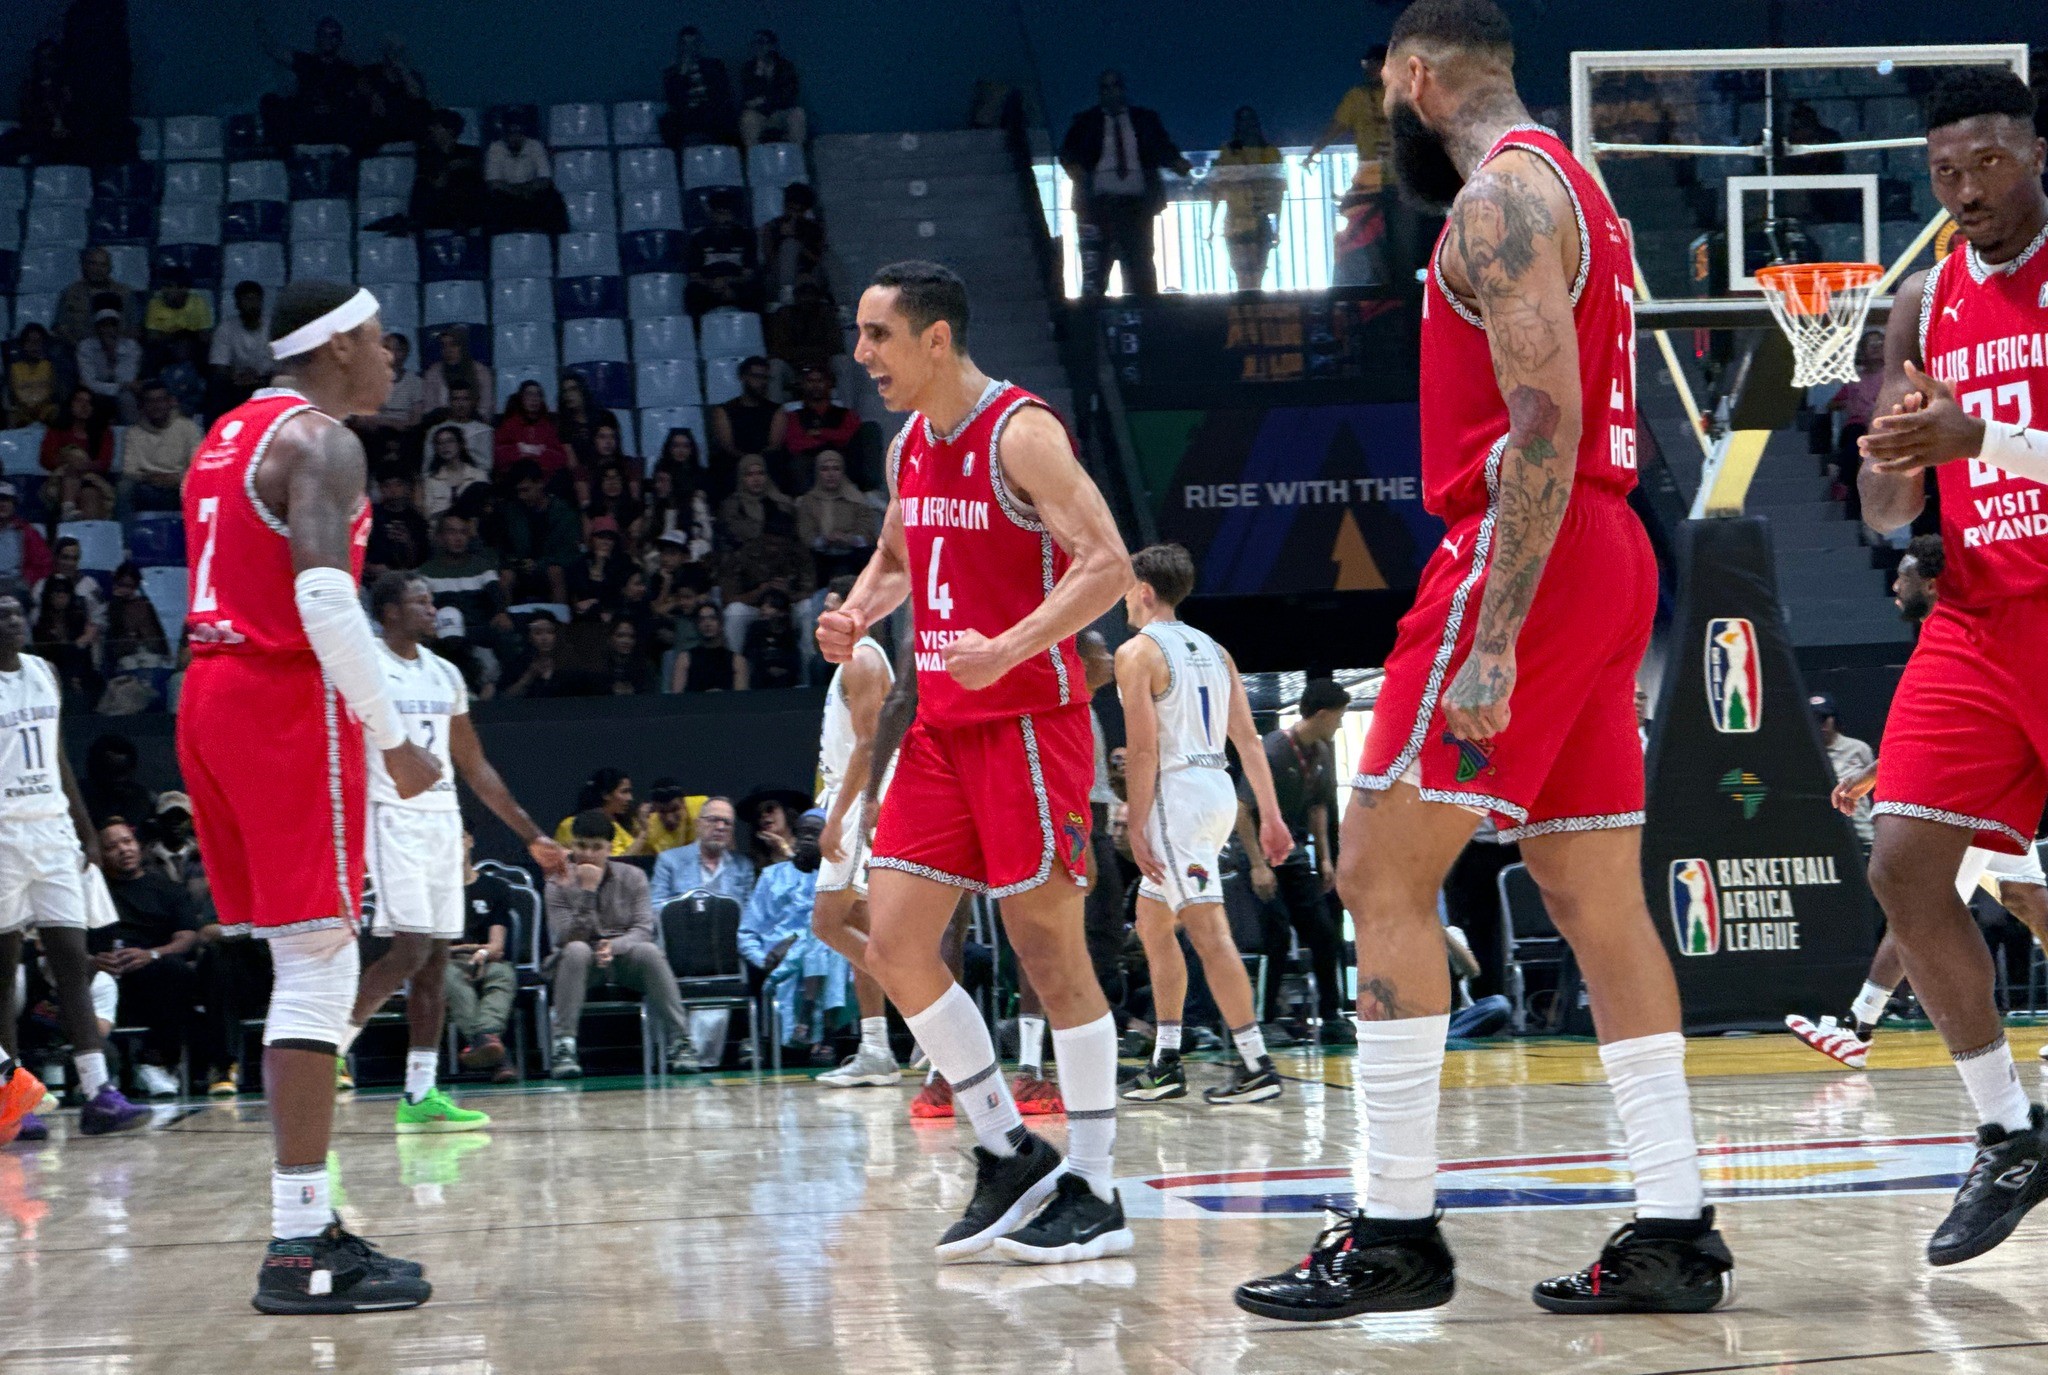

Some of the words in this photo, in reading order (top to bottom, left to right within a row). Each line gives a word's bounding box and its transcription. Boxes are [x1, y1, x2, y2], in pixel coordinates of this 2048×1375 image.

[1184, 483, 1260, 509] RISE
[1265, 480, 1350, 505] WITH
[1353, 476, 1417, 501] THE
[1973, 488, 2041, 519] VISIT
[900, 497, 919, 527] LUB
[922, 497, 989, 530] AFRICAIN
[927, 536, 954, 620] 4
[1198, 686, 1212, 747] 1
[18, 726, 45, 770] 11
[1716, 856, 1841, 887] BASKETBALL
[1722, 890, 1794, 919] AFRICA
[1724, 922, 1801, 951] LEAGUE
